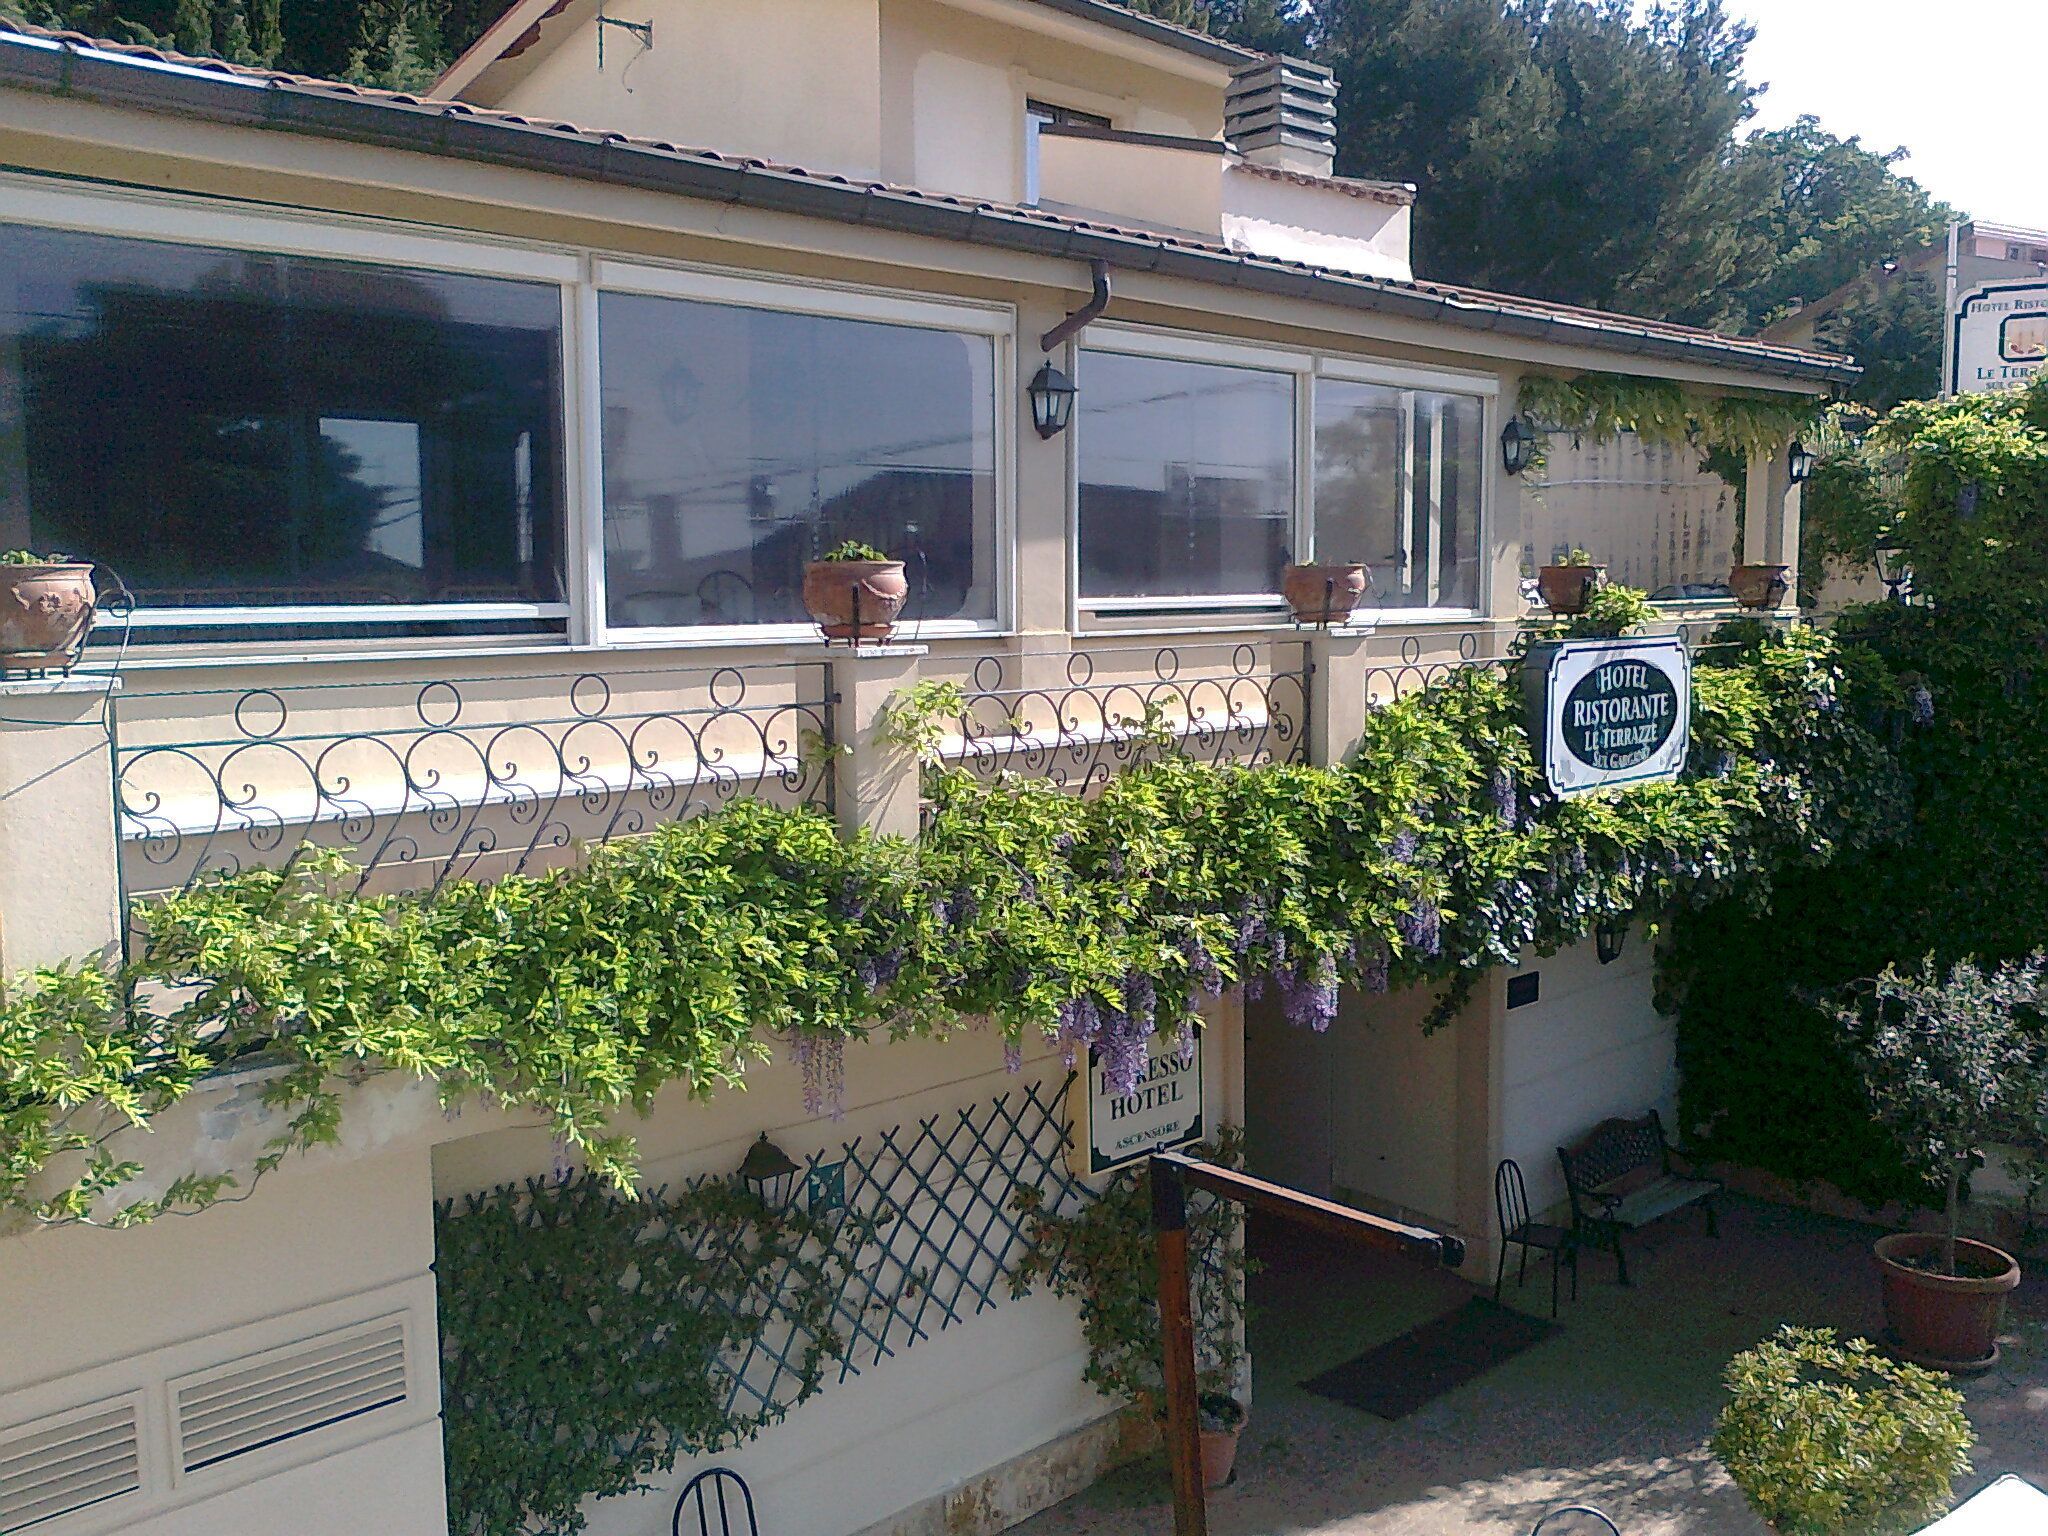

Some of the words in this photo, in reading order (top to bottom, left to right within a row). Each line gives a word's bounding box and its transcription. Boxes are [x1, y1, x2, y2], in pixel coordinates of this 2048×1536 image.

[1977, 367, 1995, 380] LE
[2000, 365, 2038, 379] TERR
[1599, 665, 1649, 694] HOTEL
[1573, 692, 1669, 727] RISTORANTE
[1585, 730, 1599, 751] LE
[1603, 722, 1658, 749] TERRAZZE
[1110, 1081, 1184, 1121] HOTEL
[1115, 1120, 1180, 1150] ASCENSORE
